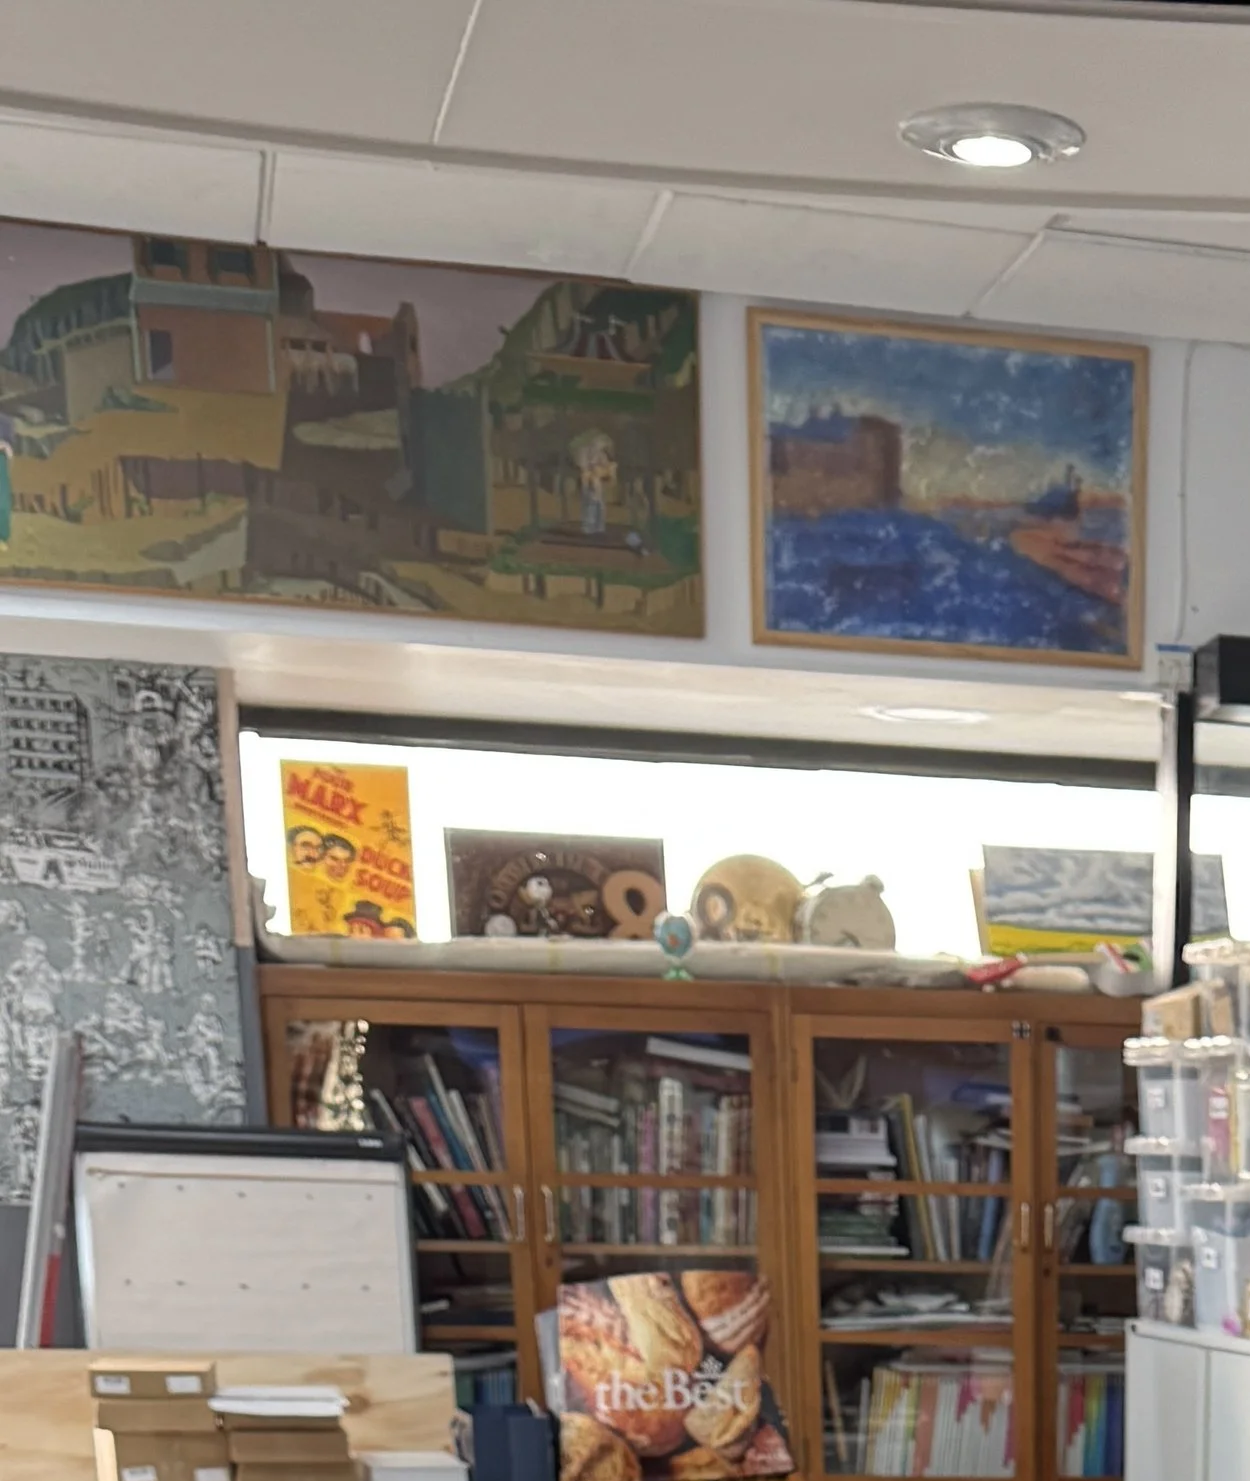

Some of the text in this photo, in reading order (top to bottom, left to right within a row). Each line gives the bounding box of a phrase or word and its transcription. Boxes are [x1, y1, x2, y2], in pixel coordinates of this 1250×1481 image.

[287, 773, 368, 826] MARX
[355, 868, 412, 902] SOUP
[594, 1366, 749, 1413] the Best
